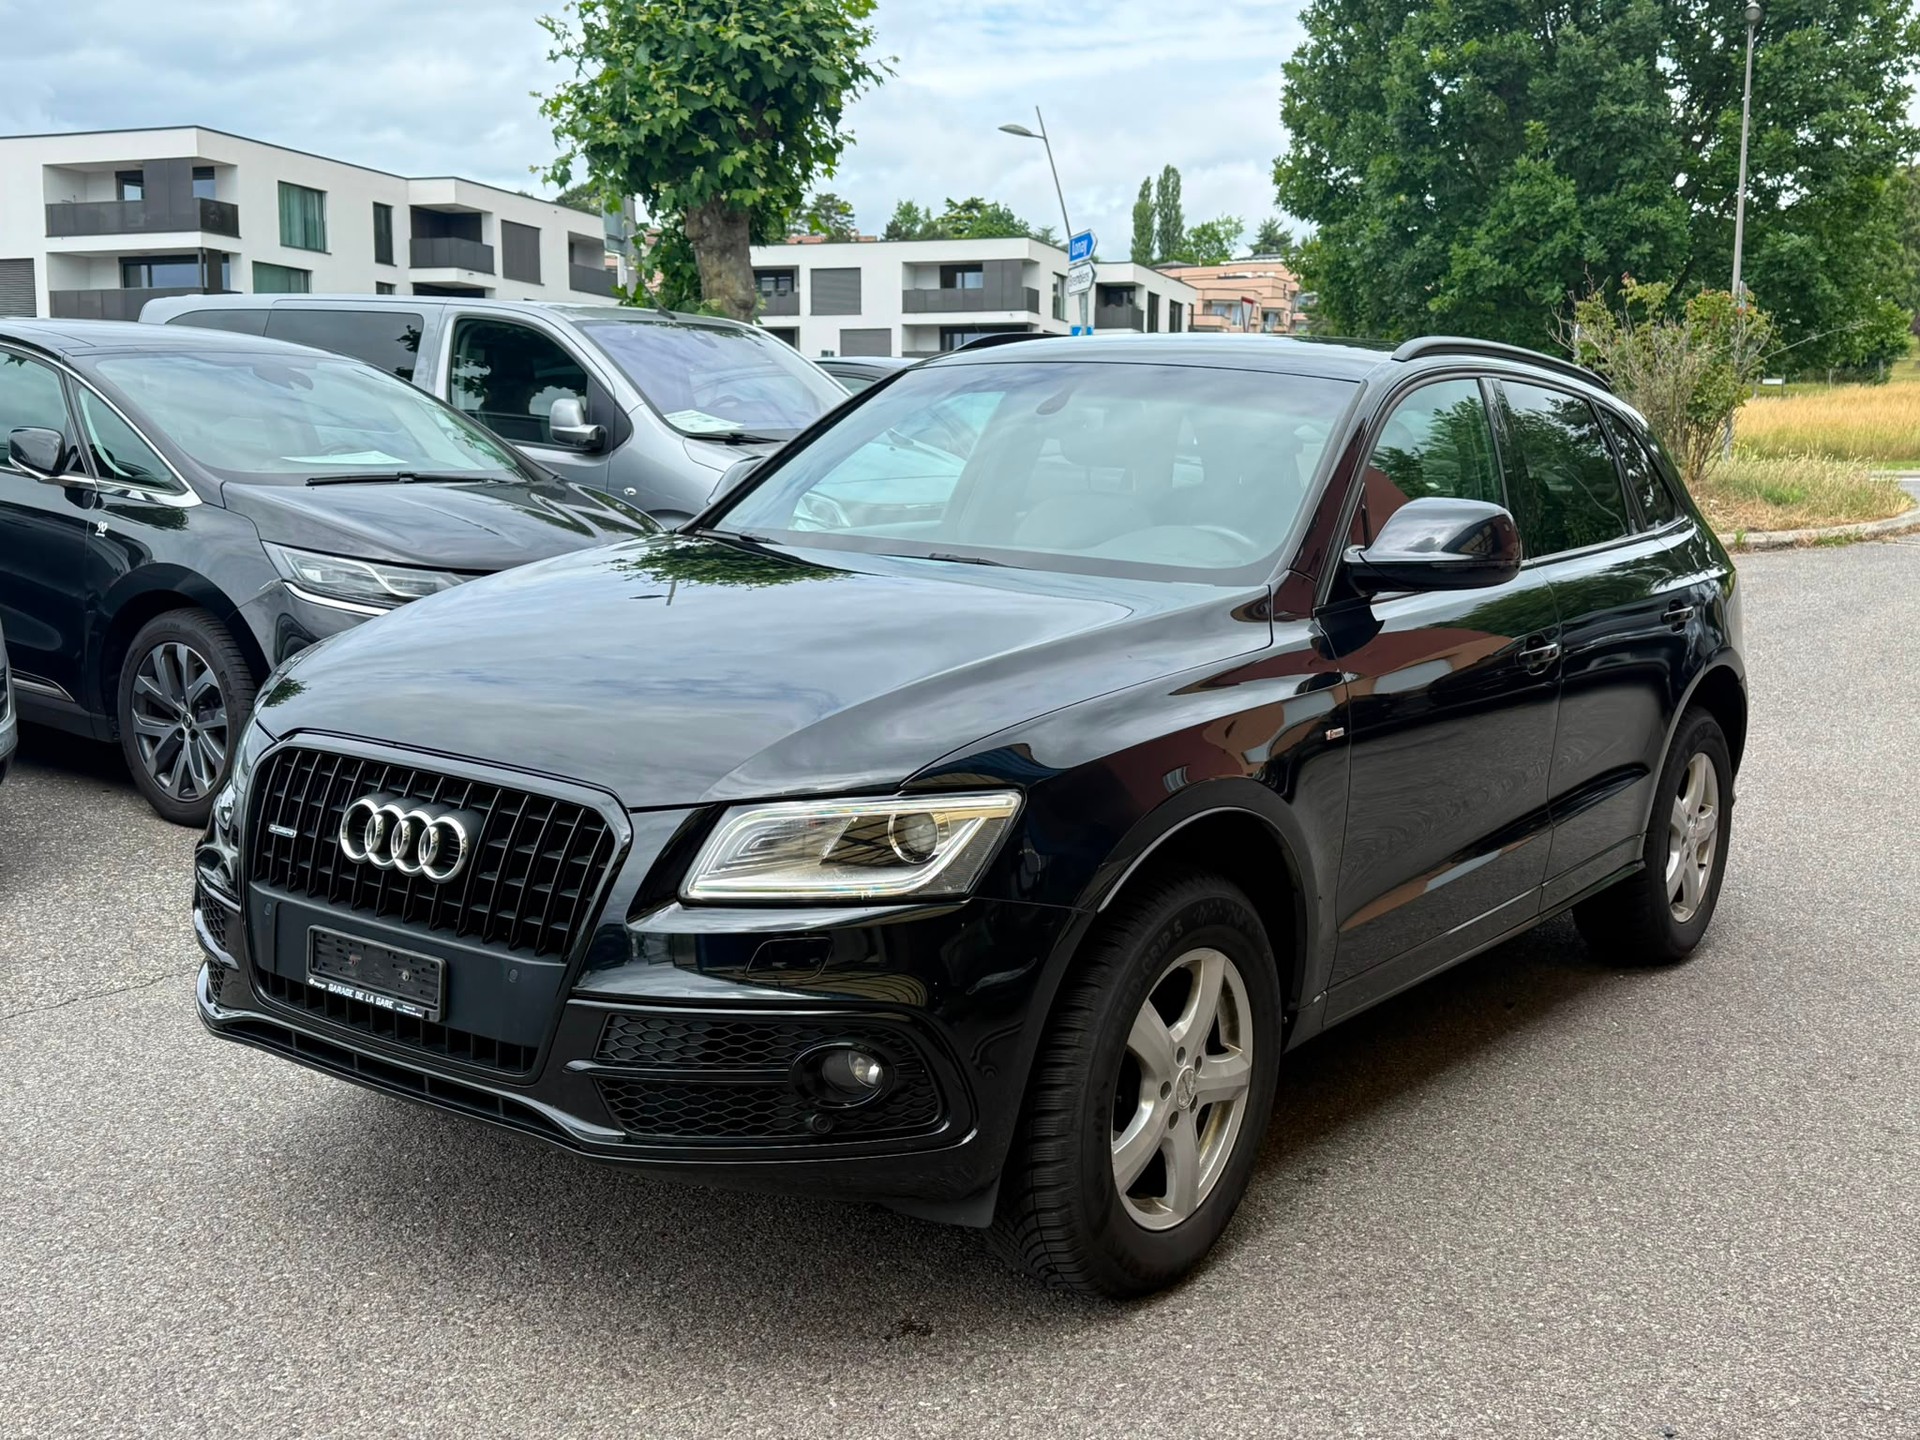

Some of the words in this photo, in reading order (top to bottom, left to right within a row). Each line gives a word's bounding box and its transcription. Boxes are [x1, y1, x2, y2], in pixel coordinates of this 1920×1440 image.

[328, 983, 354, 998] GARAGE
[355, 991, 365, 1001] DE
[365, 994, 374, 1004] LA
[376, 997, 394, 1009] GARE
